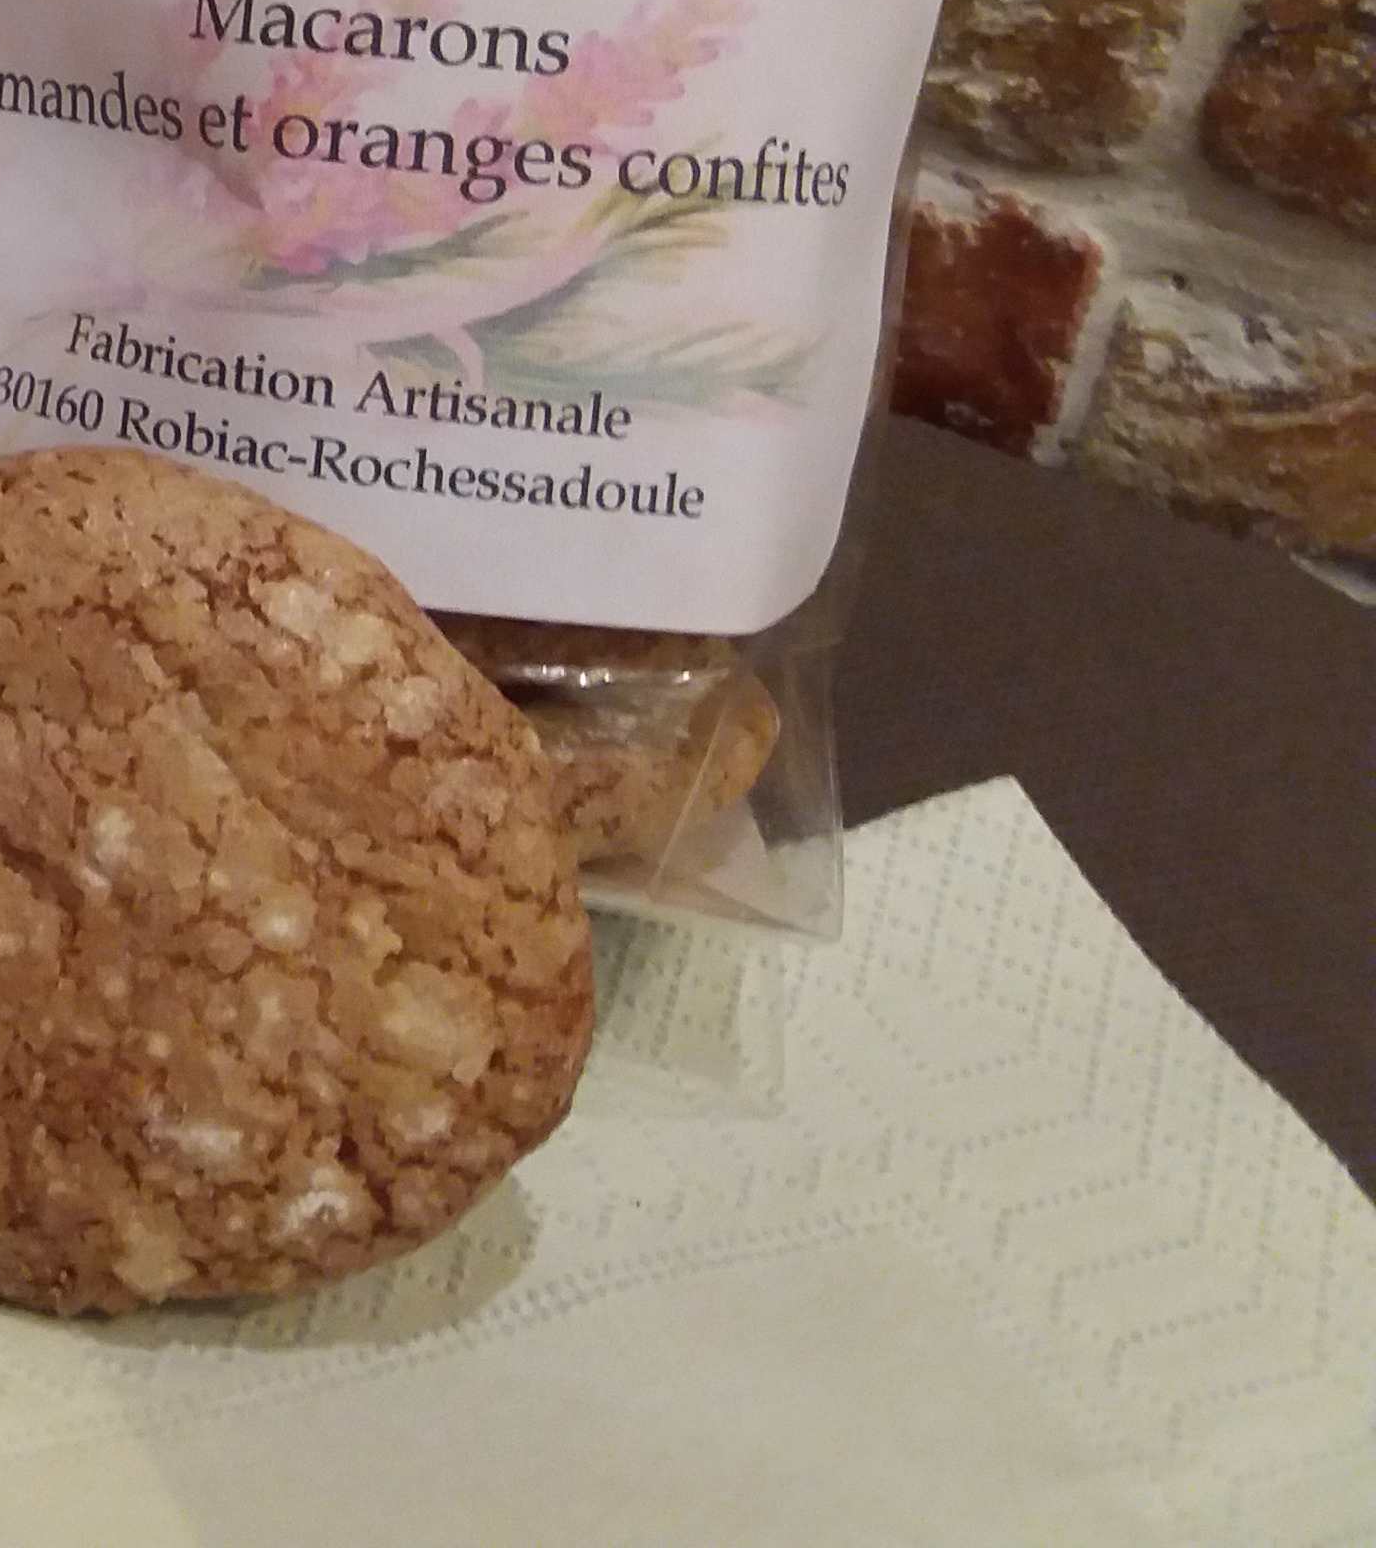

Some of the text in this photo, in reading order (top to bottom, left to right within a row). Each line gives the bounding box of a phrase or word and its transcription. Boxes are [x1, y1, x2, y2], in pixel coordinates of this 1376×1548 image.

[199, 95, 252, 152] et
[273, 115, 592, 203] oranges
[619, 138, 848, 205] confites
[66, 313, 630, 438] Fabrication Artisanale
[117, 397, 705, 520] Robiac-Rochessadoule
